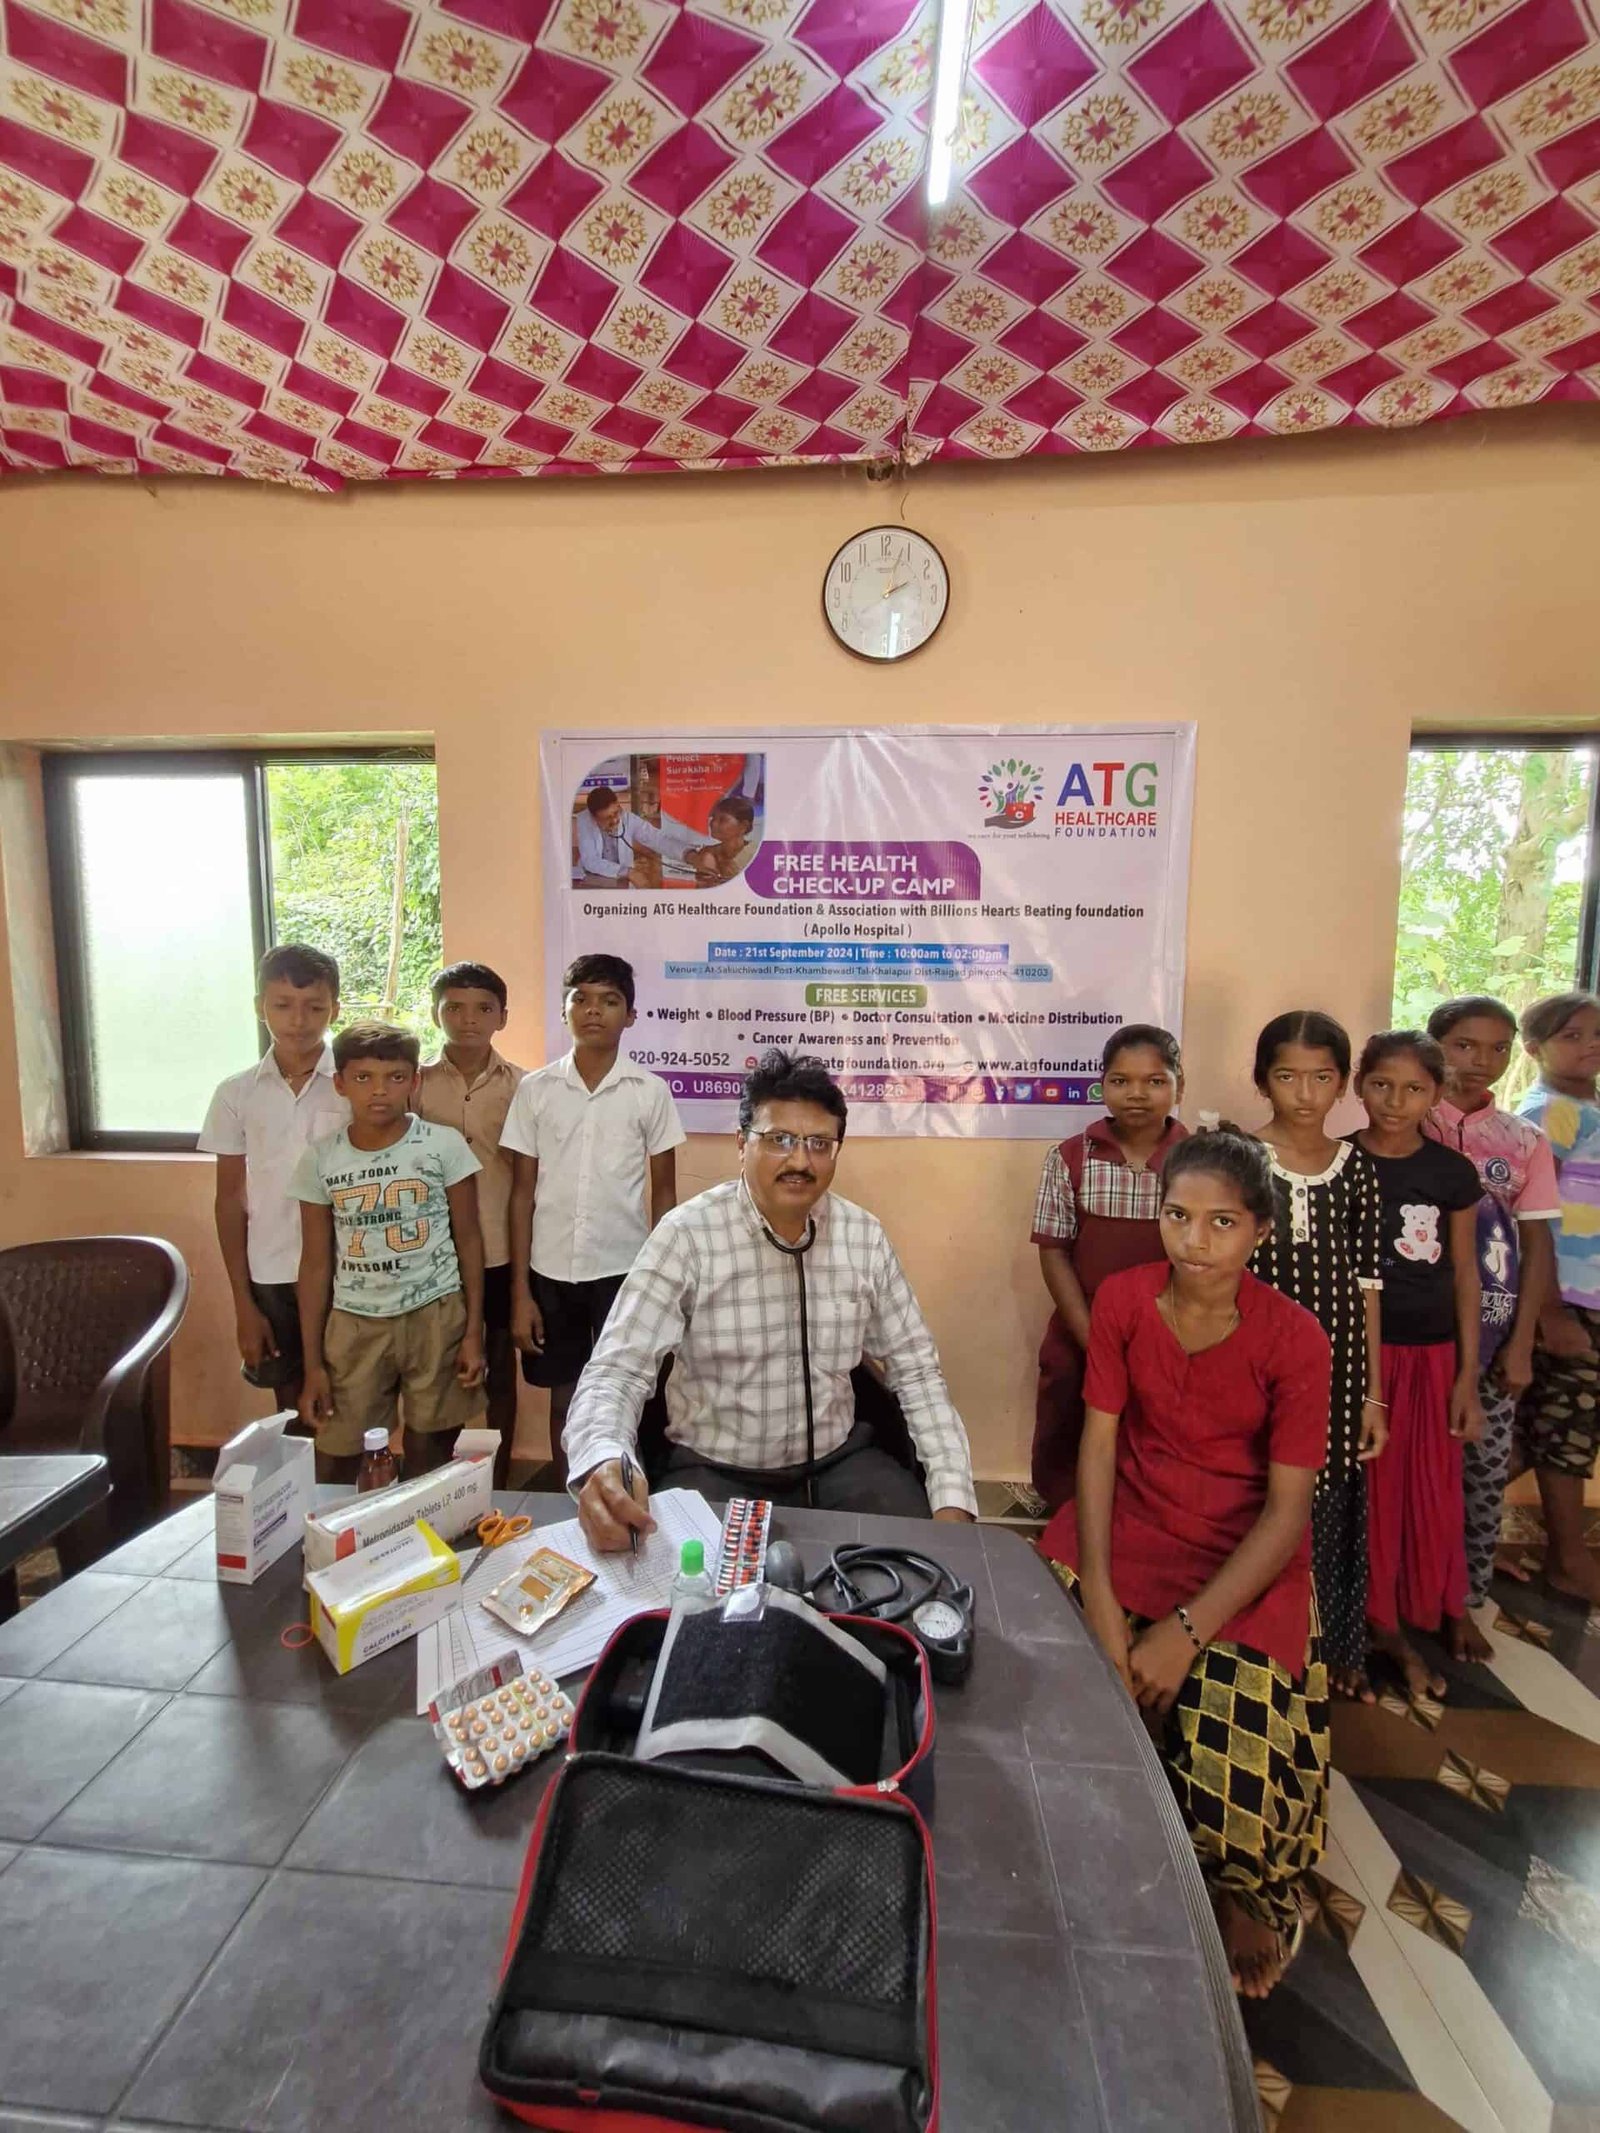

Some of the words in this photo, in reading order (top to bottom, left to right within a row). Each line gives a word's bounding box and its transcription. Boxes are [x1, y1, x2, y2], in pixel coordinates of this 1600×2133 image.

[859, 542, 867, 567] 11
[880, 535, 891, 557] 12
[840, 562, 851, 583] 10
[923, 559, 930, 580] 2
[930, 583, 937, 605] 3
[1056, 762, 1158, 808] ATG
[1055, 812, 1157, 826] HEALTHCARE
[1055, 827, 1157, 838] FOUNDATION
[773, 855, 824, 872] FREE
[831, 855, 917, 873] HEALTH
[772, 878, 885, 895] CHECK-UP
[892, 878, 955, 895] CAMP
[583, 903, 648, 918] Organizing
[653, 903, 674, 916] ATG
[677, 903, 741, 916] Healthcare
[744, 903, 813, 916] Foundation
[815, 904, 825, 916] &
[828, 904, 897, 917] Association
[900, 904, 927, 917] with
[930, 904, 977, 917] Billions
[981, 904, 1020, 918] Hearts
[1024, 904, 1072, 920] Beating
[1075, 904, 1144, 918] foundation
[811, 924, 850, 938] Apollo
[853, 924, 904, 939] Hospital
[714, 947, 737, 958] Date
[745, 947, 767, 958] 21st
[769, 946, 824, 961] September
[826, 947, 853, 958] 2024
[860, 947, 885, 959] Time
[895, 947, 939, 959] 10:00am
[942, 947, 952, 959] to
[669, 966, 697, 975] Venue
[816, 988, 848, 1002] FREE
[852, 989, 916, 1003] SERVICES
[657, 1008, 701, 1023] Weight
[717, 1008, 751, 1021] Blood
[755, 1008, 806, 1022] Pressure
[809, 1009, 835, 1023] (BP)
[852, 1011, 892, 1024] Doctor
[1048, 1011, 1123, 1025] Distribution
[753, 1032, 793, 1045] Cancer
[799, 1033, 864, 1046] Awareness
[866, 1033, 887, 1046] and
[892, 1033, 959, 1047] Prevention
[326, 1172, 354, 1187] MAKE
[360, 1165, 399, 1180] TODAY
[341, 1259, 402, 1273] AWESOME
[363, 1515, 415, 1548] Metronidazole
